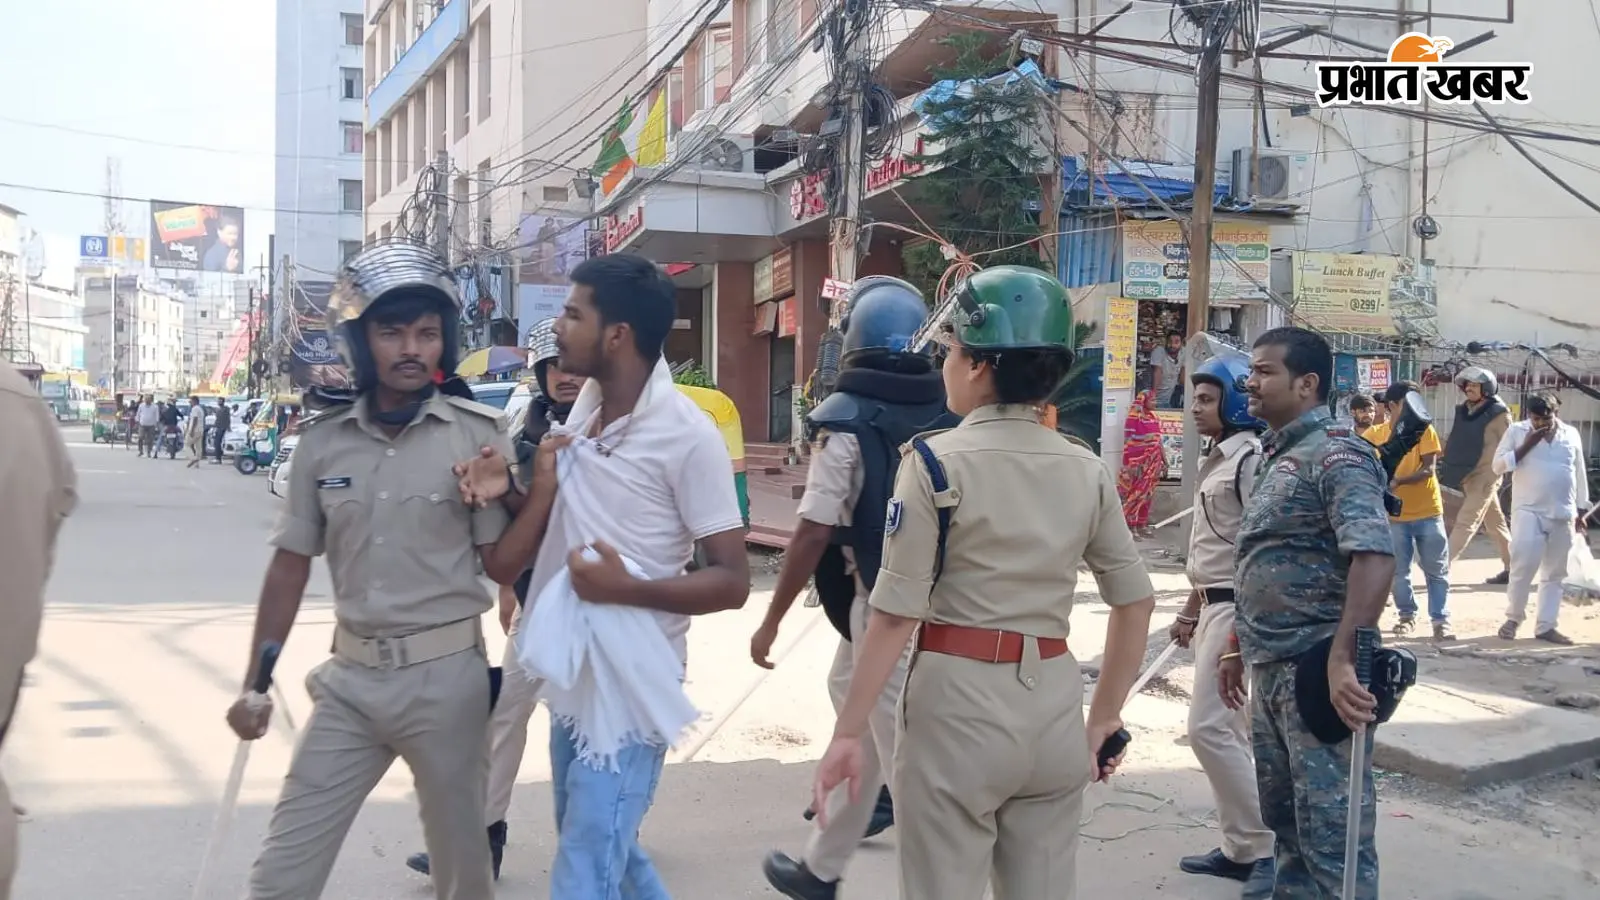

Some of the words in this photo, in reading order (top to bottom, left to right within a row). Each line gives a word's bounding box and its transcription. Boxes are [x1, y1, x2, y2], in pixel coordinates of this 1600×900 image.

[1322, 265, 1354, 277] Lunch
[1356, 265, 1386, 280] Buffet
[1323, 452, 1362, 466] COMMANDO
